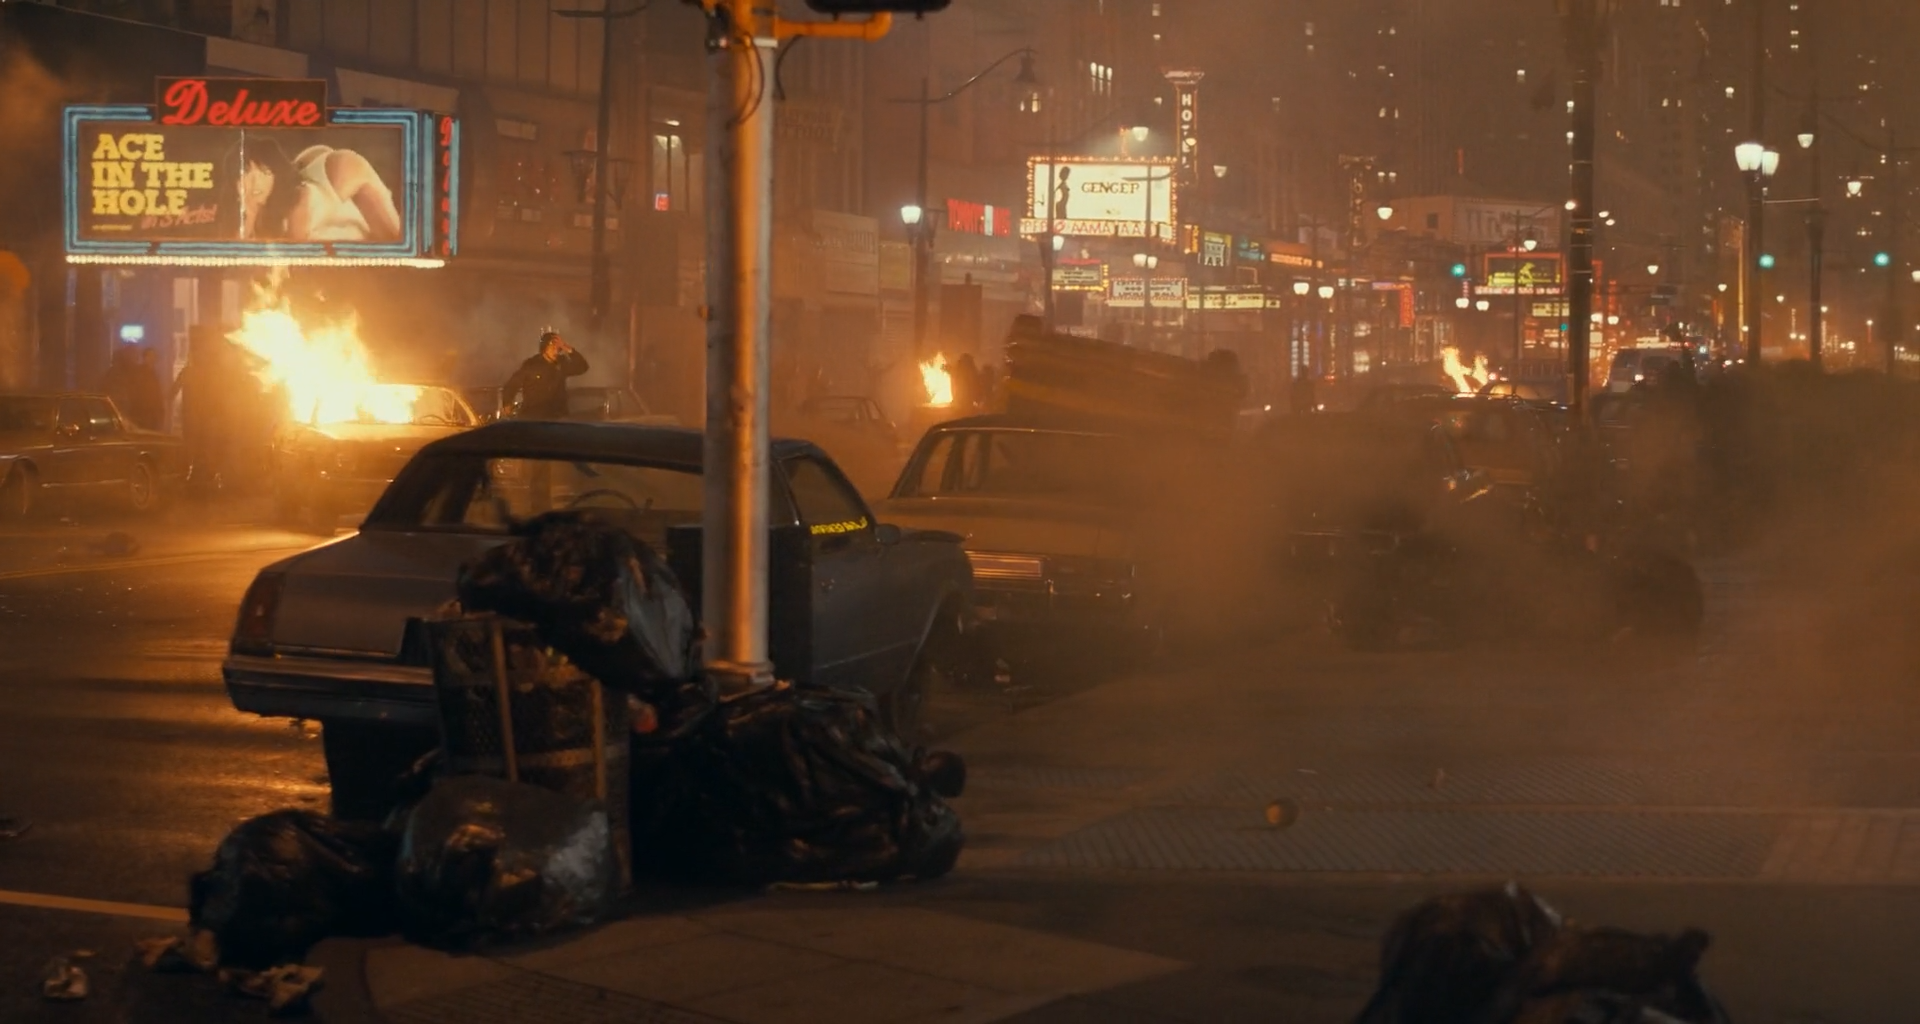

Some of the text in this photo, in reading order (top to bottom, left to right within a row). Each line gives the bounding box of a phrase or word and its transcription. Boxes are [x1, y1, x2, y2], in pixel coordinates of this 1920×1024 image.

[161, 79, 321, 126] Deluxe
[1181, 93, 1193, 169] HOTEL
[92, 133, 165, 160] ACE
[91, 161, 214, 189] IN THE
[92, 189, 188, 216] HOLE
